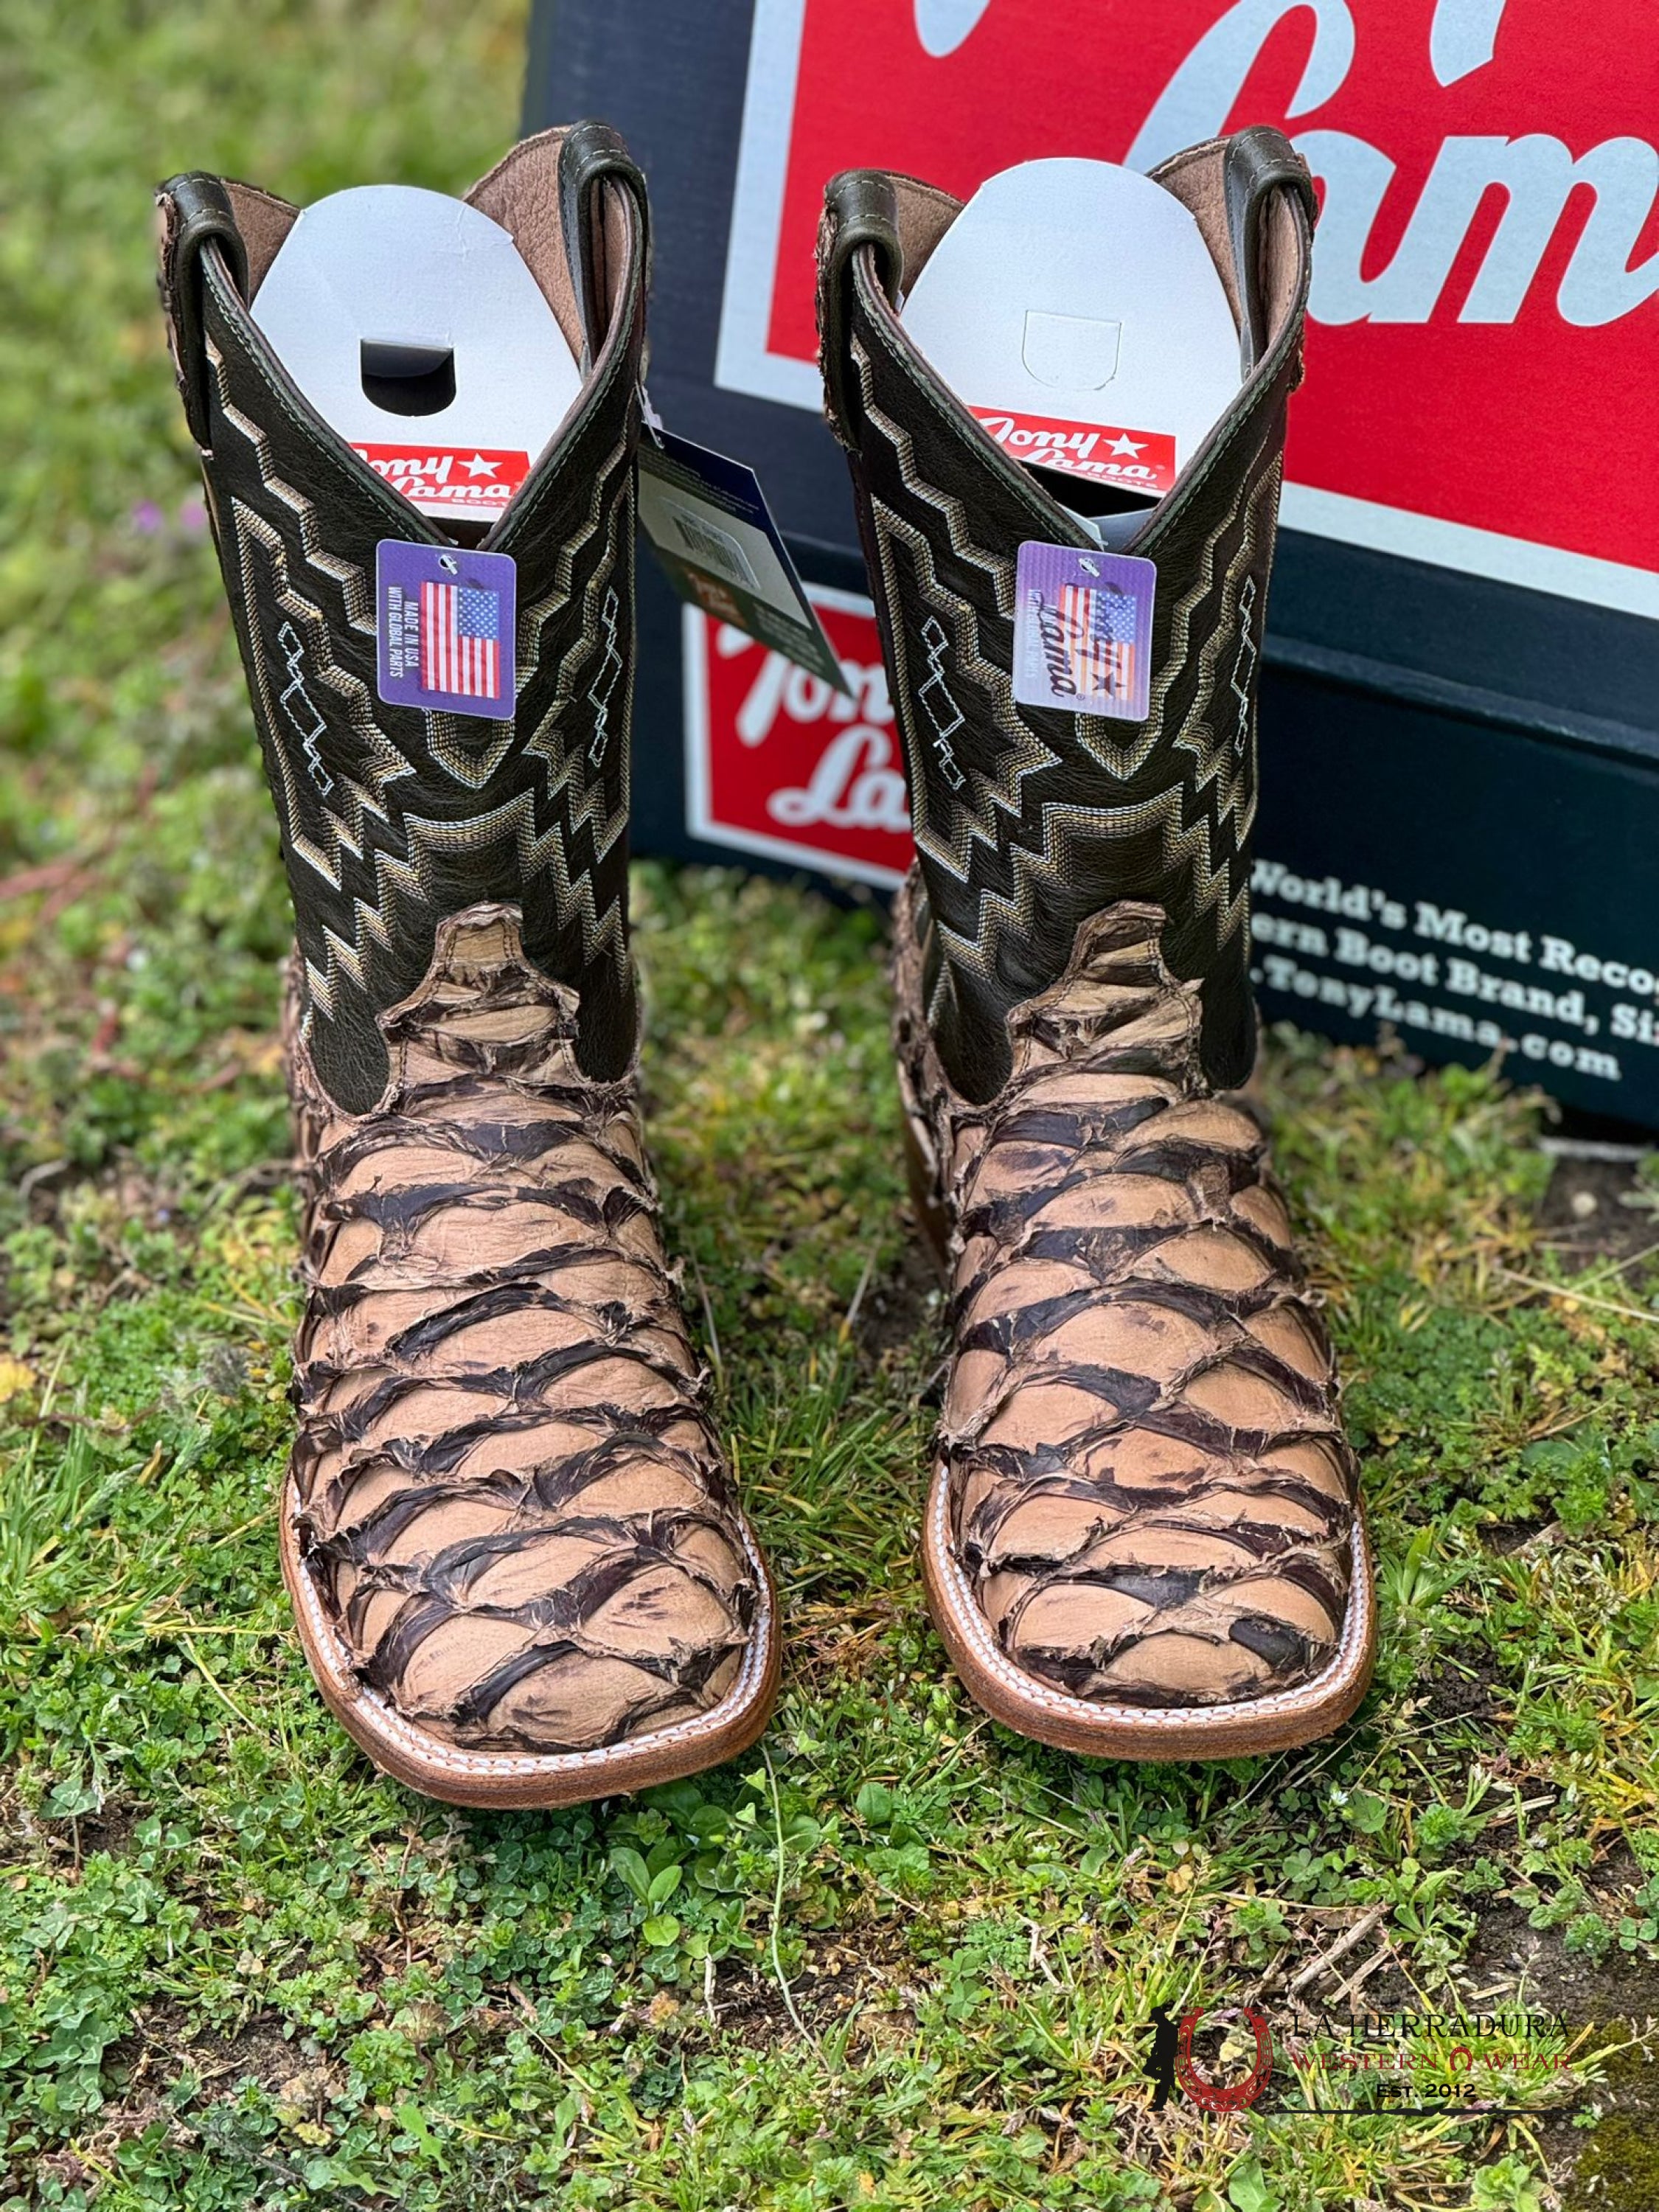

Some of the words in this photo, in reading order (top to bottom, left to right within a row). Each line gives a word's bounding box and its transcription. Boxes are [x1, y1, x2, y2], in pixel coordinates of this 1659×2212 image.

[388, 586, 403, 611] WITH
[389, 612, 403, 647] GLOBAL
[403, 601, 419, 632] MADE
[404, 633, 419, 646] IN
[1037, 591, 1085, 698] Lama
[389, 648, 404, 678] PARTS
[404, 647, 420, 667] USA
[1251, 858, 1407, 930] World's
[1413, 900, 1532, 964] Most
[1333, 926, 1439, 987] Boot
[1445, 956, 1599, 1037] Brand,
